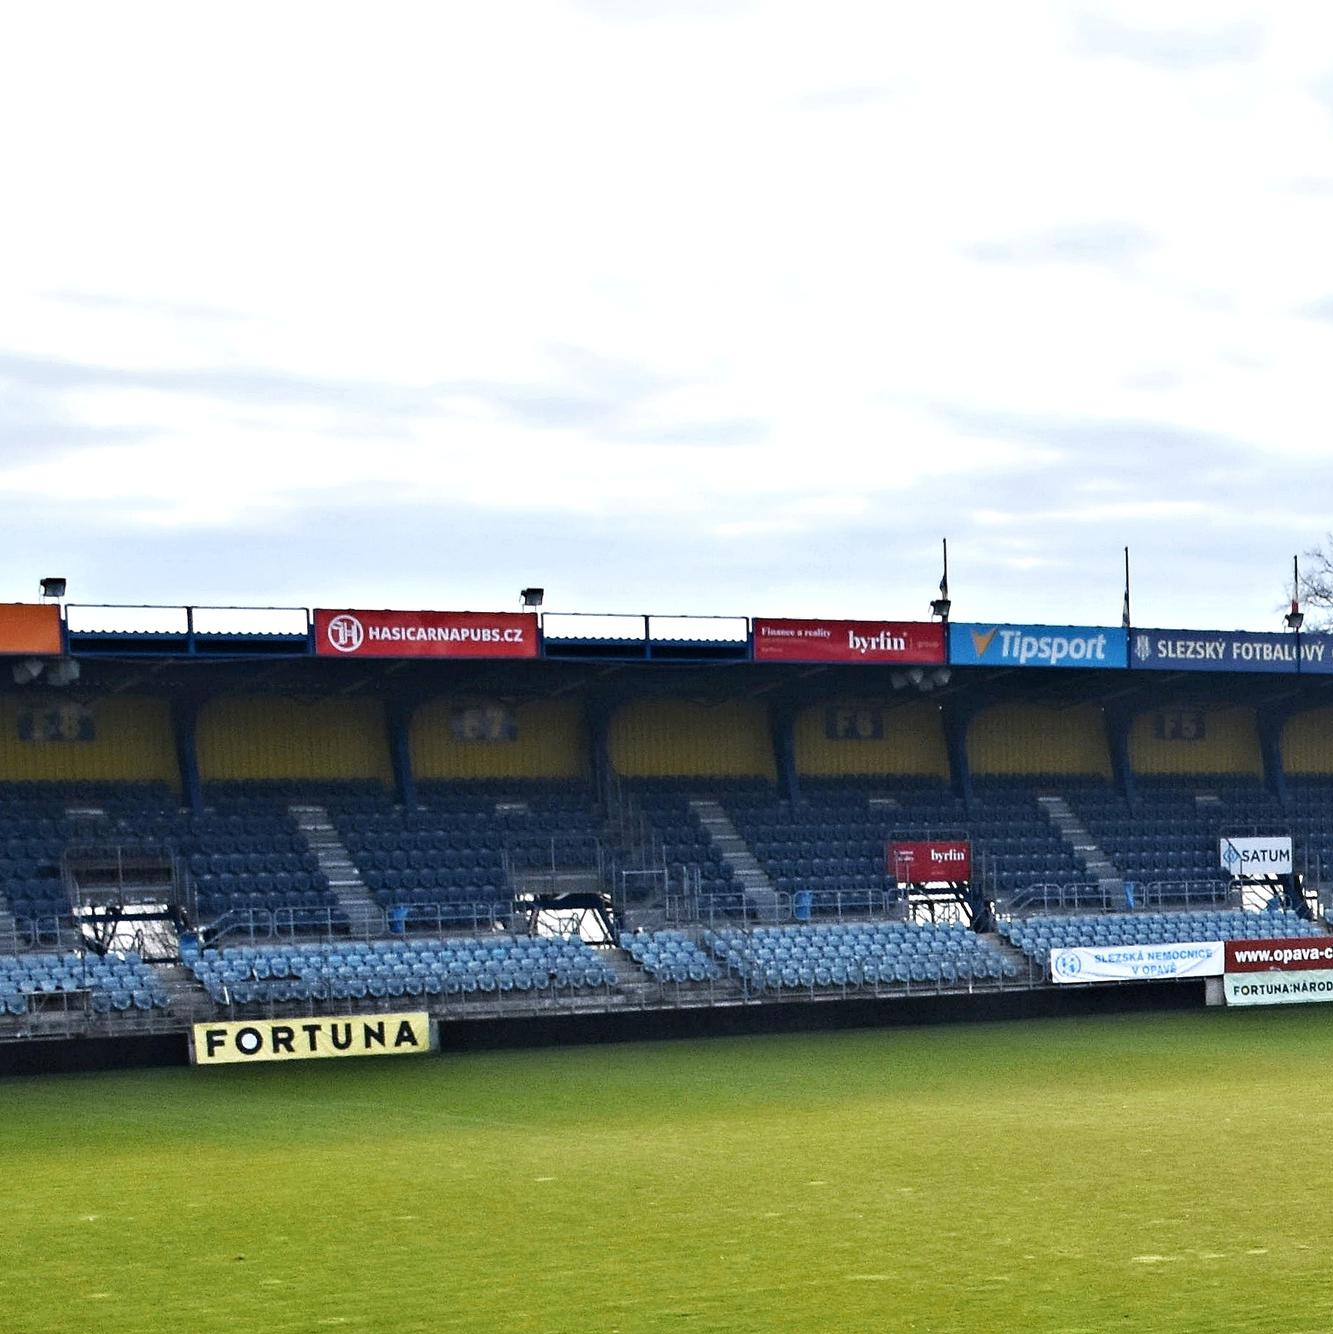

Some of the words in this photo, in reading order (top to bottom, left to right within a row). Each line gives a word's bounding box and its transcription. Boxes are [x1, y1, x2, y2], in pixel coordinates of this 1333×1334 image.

[369, 627, 523, 642] HASICARNAPUBS.CZ
[1000, 630, 1106, 664] Tipsport
[1158, 638, 1226, 660] SLEZSKÝ
[1232, 641, 1325, 662] FOTBALOVÝ
[1242, 849, 1290, 862] SATUM
[1094, 951, 1143, 963] SLEZSKÁ
[1148, 949, 1212, 961] NEMOCNICE
[1132, 966, 1139, 974] V
[206, 1021, 418, 1057] FORTUNA
